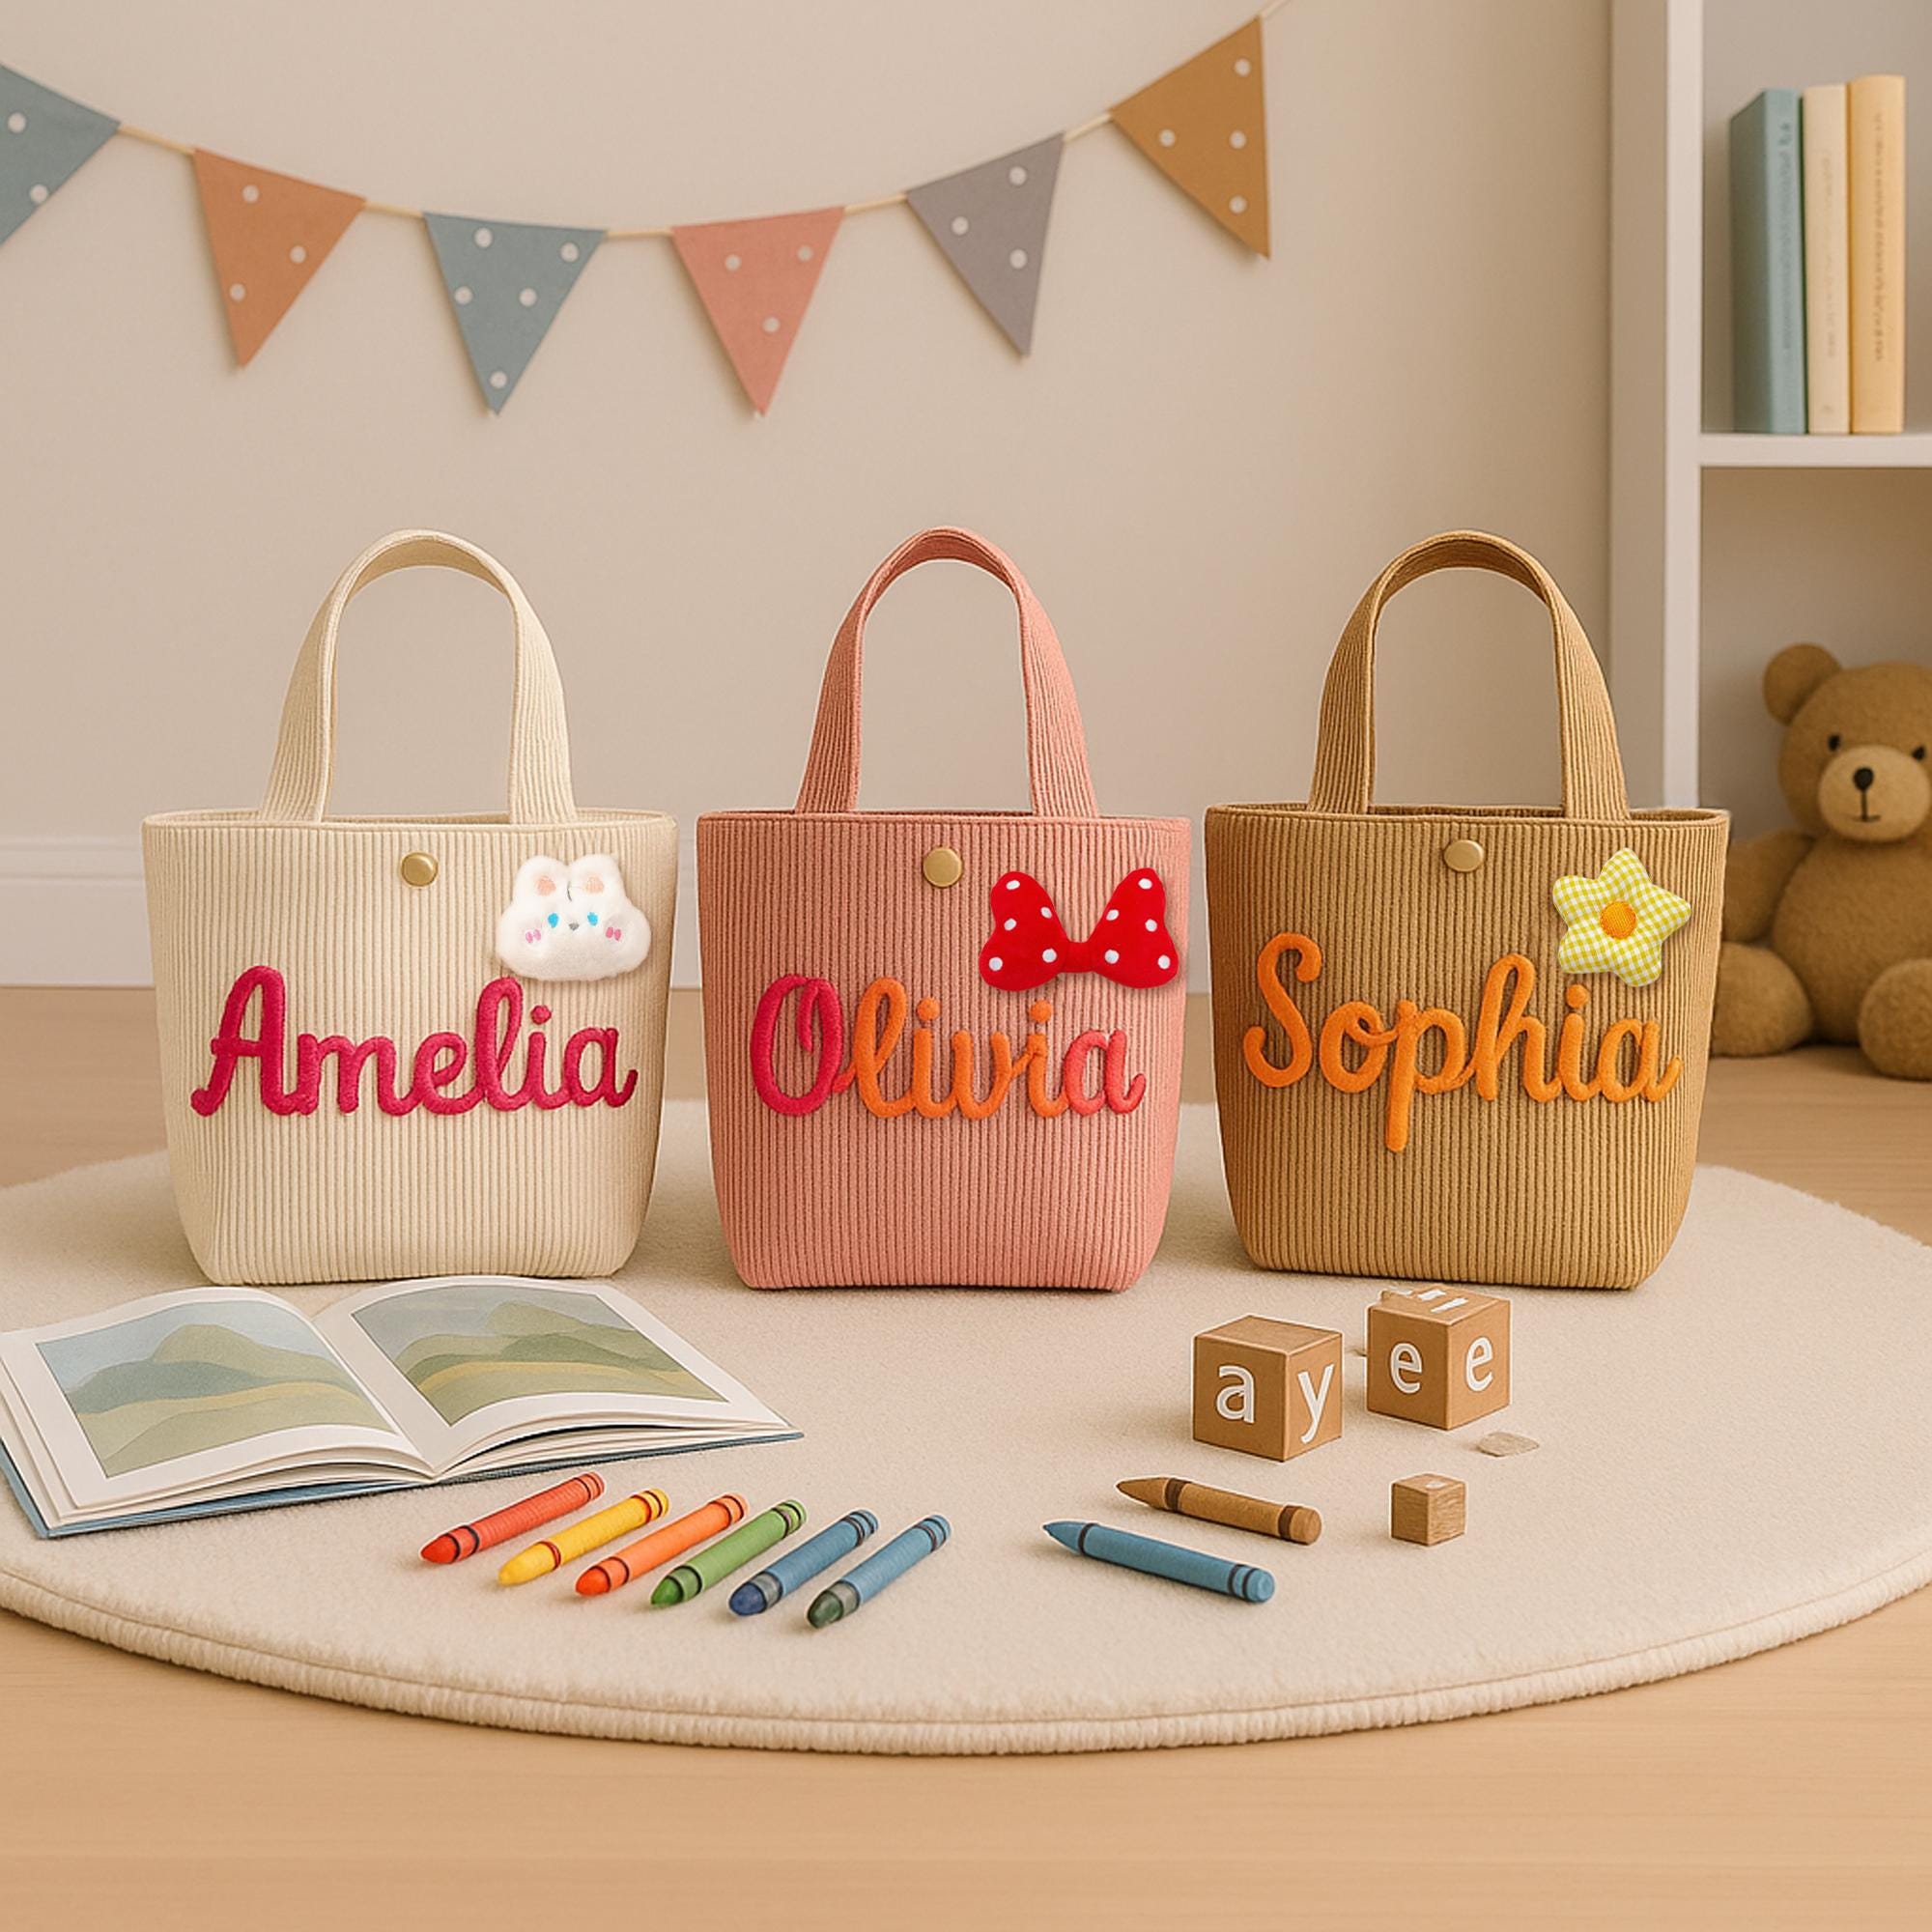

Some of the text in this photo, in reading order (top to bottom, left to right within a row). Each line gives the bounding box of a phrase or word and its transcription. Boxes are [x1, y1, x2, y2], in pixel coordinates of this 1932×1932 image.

[190, 966, 638, 1117] Amelia
[750, 974, 1147, 1120] Olivia
[1243, 932, 1684, 1152] Sophia
[1214, 1364, 1256, 1425] a
[1297, 1363, 1335, 1444] y
[1389, 1342, 1423, 1395] e
[1465, 1336, 1494, 1392] e
